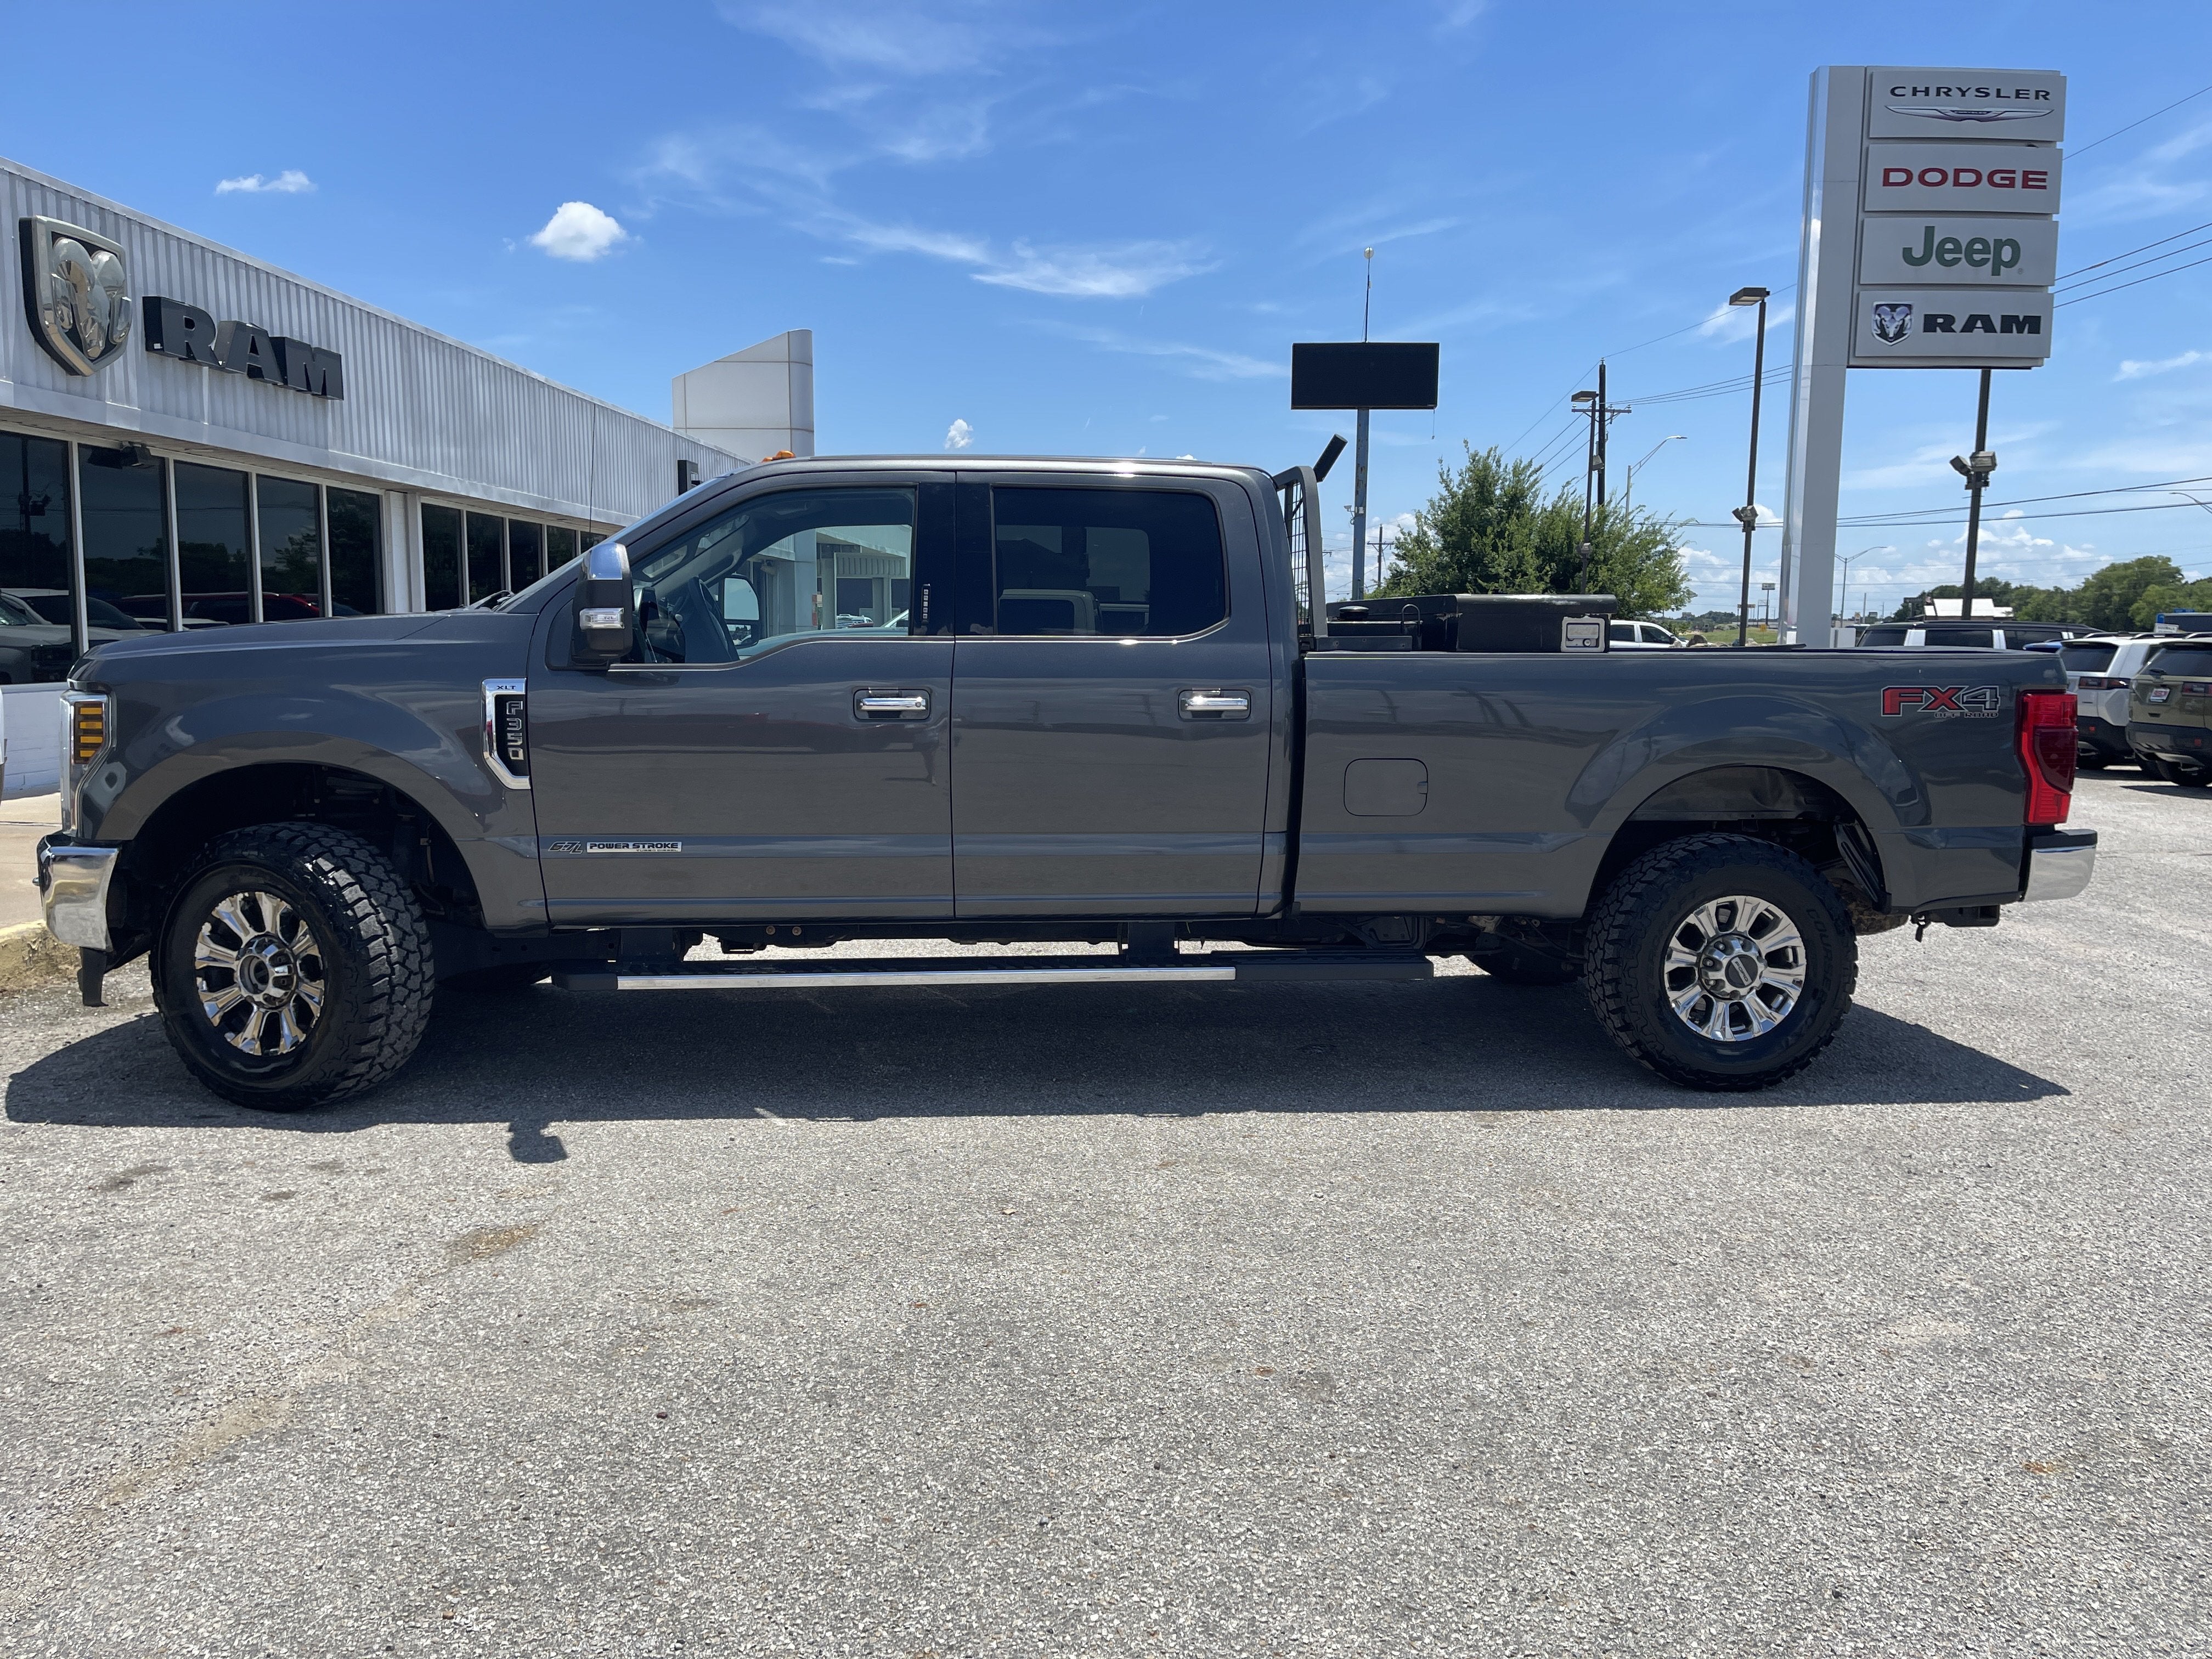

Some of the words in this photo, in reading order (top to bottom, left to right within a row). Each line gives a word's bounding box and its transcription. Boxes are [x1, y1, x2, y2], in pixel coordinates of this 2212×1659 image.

[1889, 86, 2051, 101] CHRYSLER
[1882, 167, 2048, 190] DODGE
[1902, 225, 2021, 276] Jeep
[1922, 313, 2041, 335] RAM
[142, 296, 344, 400] RAM
[1881, 686, 2000, 716] FX4
[506, 701, 524, 760] F350
[1735, 961, 1748, 982] FORD
